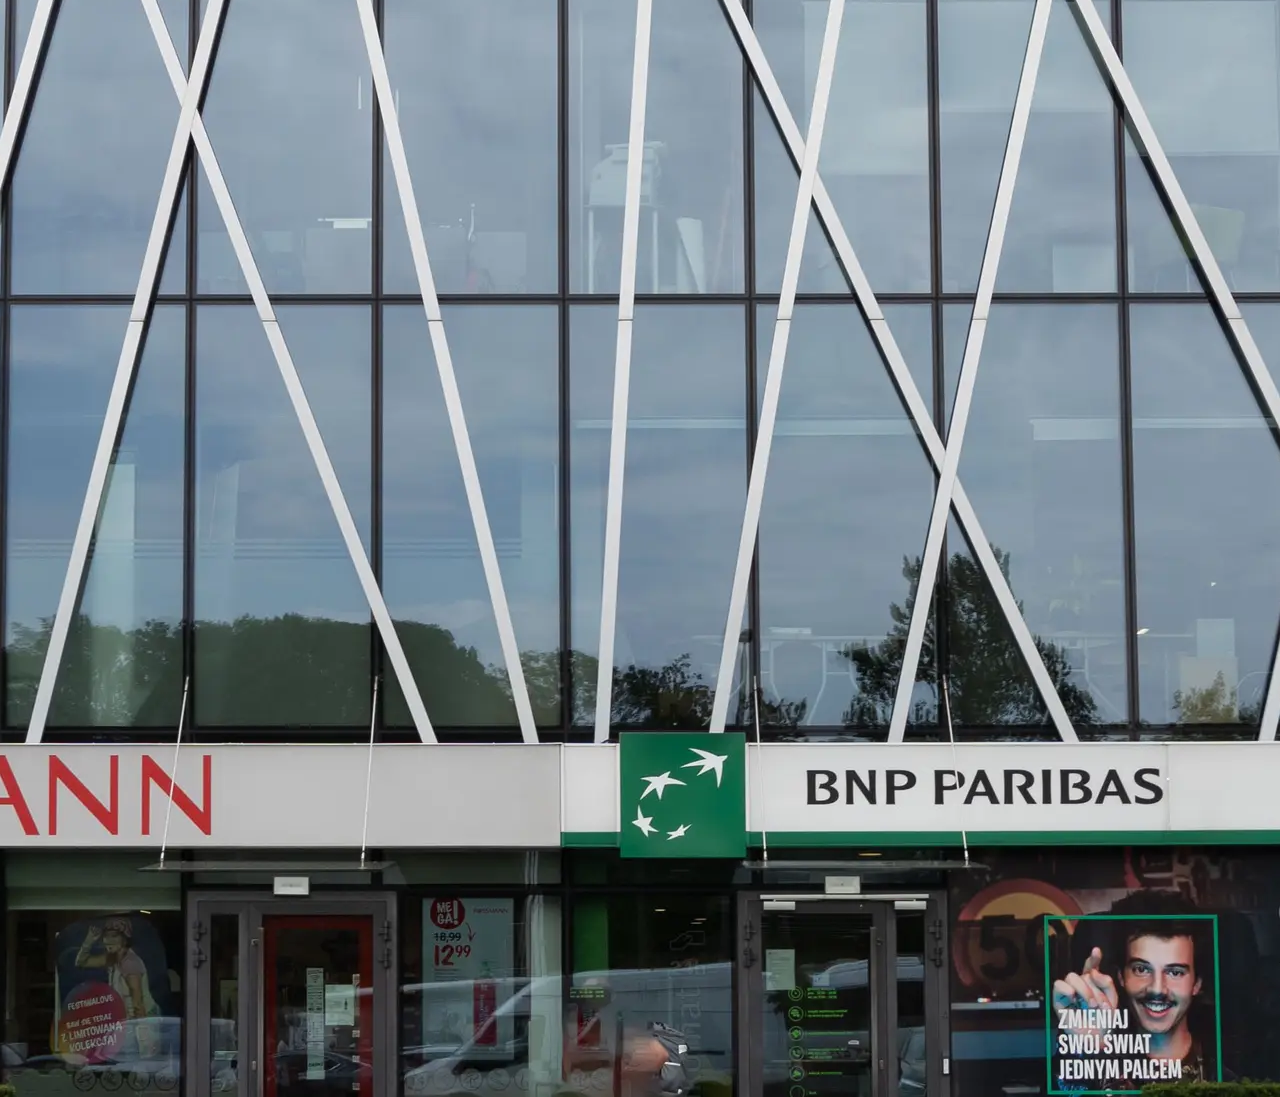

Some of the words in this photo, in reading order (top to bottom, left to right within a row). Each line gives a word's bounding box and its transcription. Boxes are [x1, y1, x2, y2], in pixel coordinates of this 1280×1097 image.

[806, 769, 917, 805] BNP
[934, 768, 1164, 805] PARIBAS
[1058, 1008, 1129, 1029] ZMIENIAJ
[1058, 1030, 1100, 1054] SWÓJ
[1103, 1030, 1152, 1054] ŚWIAT
[1058, 1059, 1120, 1080] JEDNYM
[1122, 1059, 1182, 1080] PALCEM
